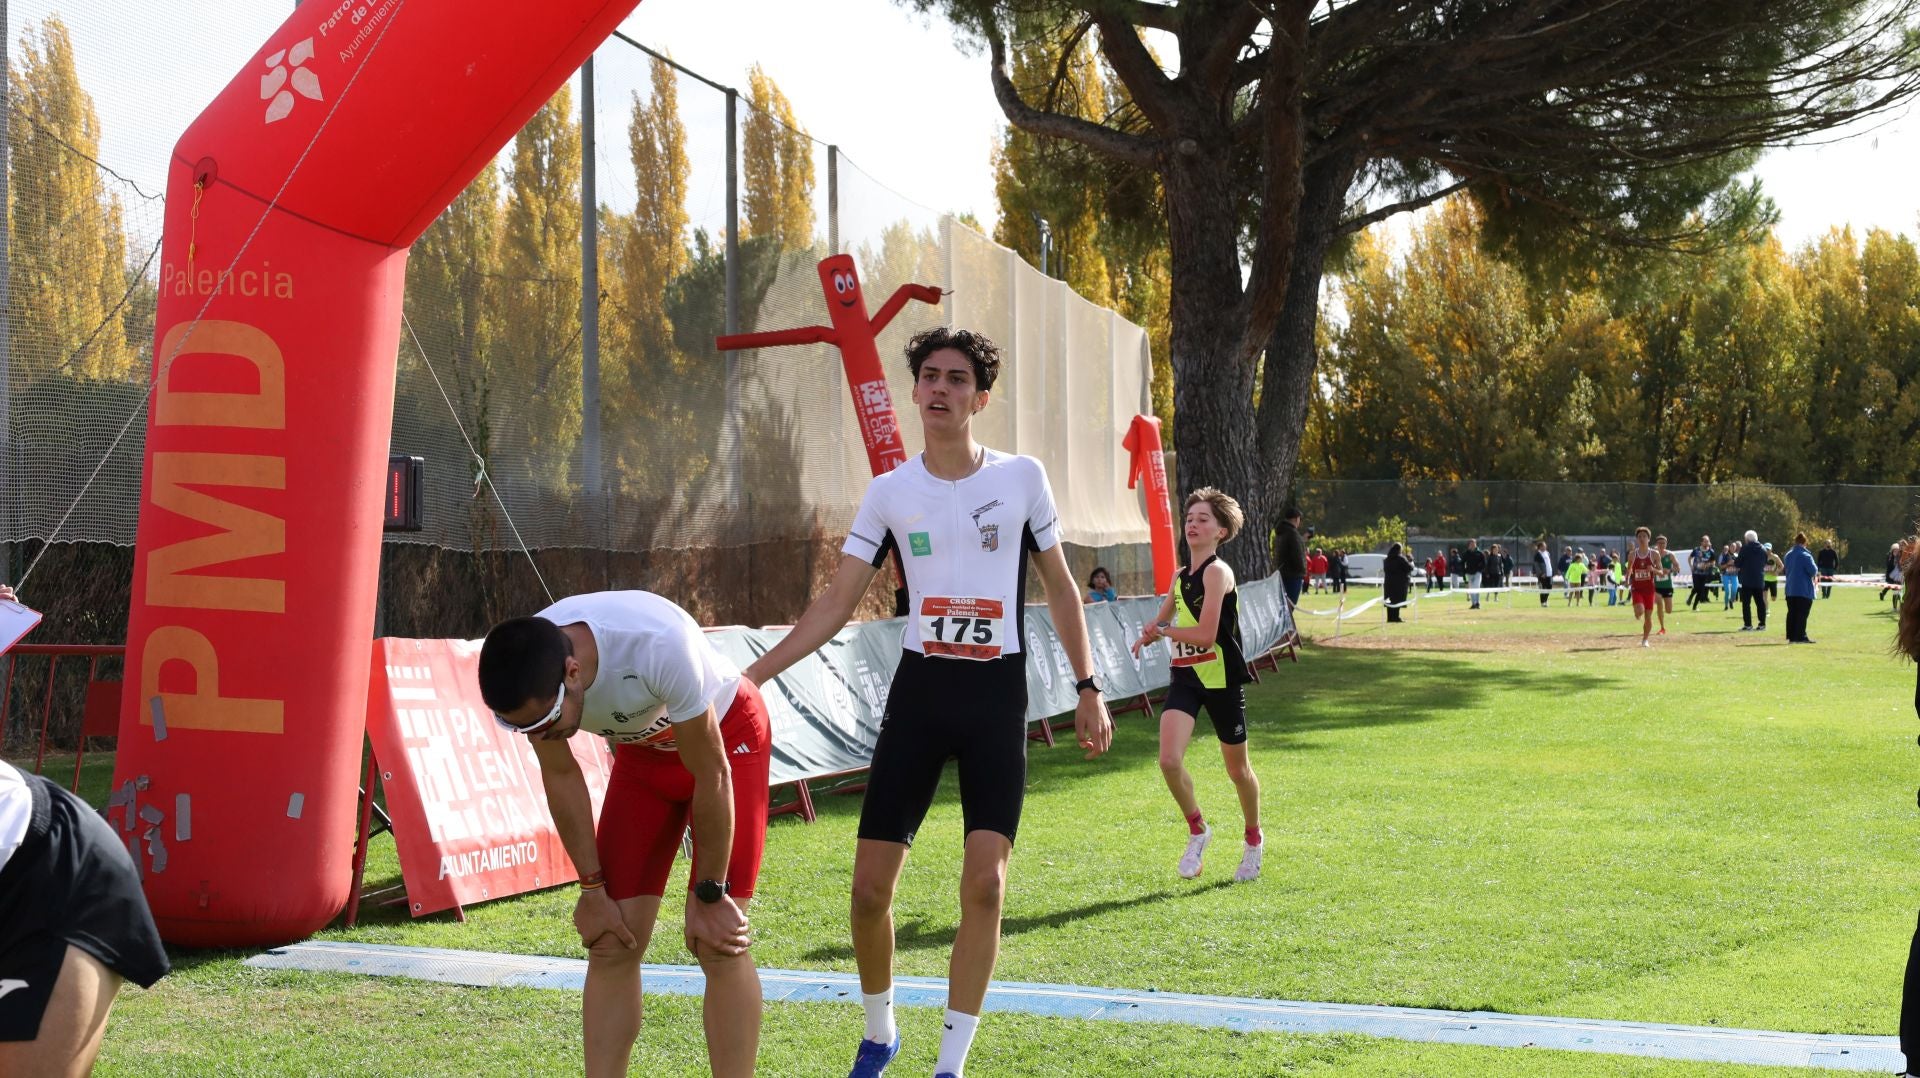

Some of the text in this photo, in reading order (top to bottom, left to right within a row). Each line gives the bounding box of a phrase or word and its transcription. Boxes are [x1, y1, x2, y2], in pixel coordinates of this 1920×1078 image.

[340, 0, 398, 63] Ayuntamient
[351, 6, 367, 25] de
[163, 261, 294, 299] Palencia
[870, 417, 883, 444] CIA
[139, 319, 286, 734] PMD
[931, 617, 993, 645] 175
[947, 609, 979, 617] Palencia
[450, 707, 490, 748] PA
[464, 750, 519, 792] LEN
[482, 794, 533, 837] CIA
